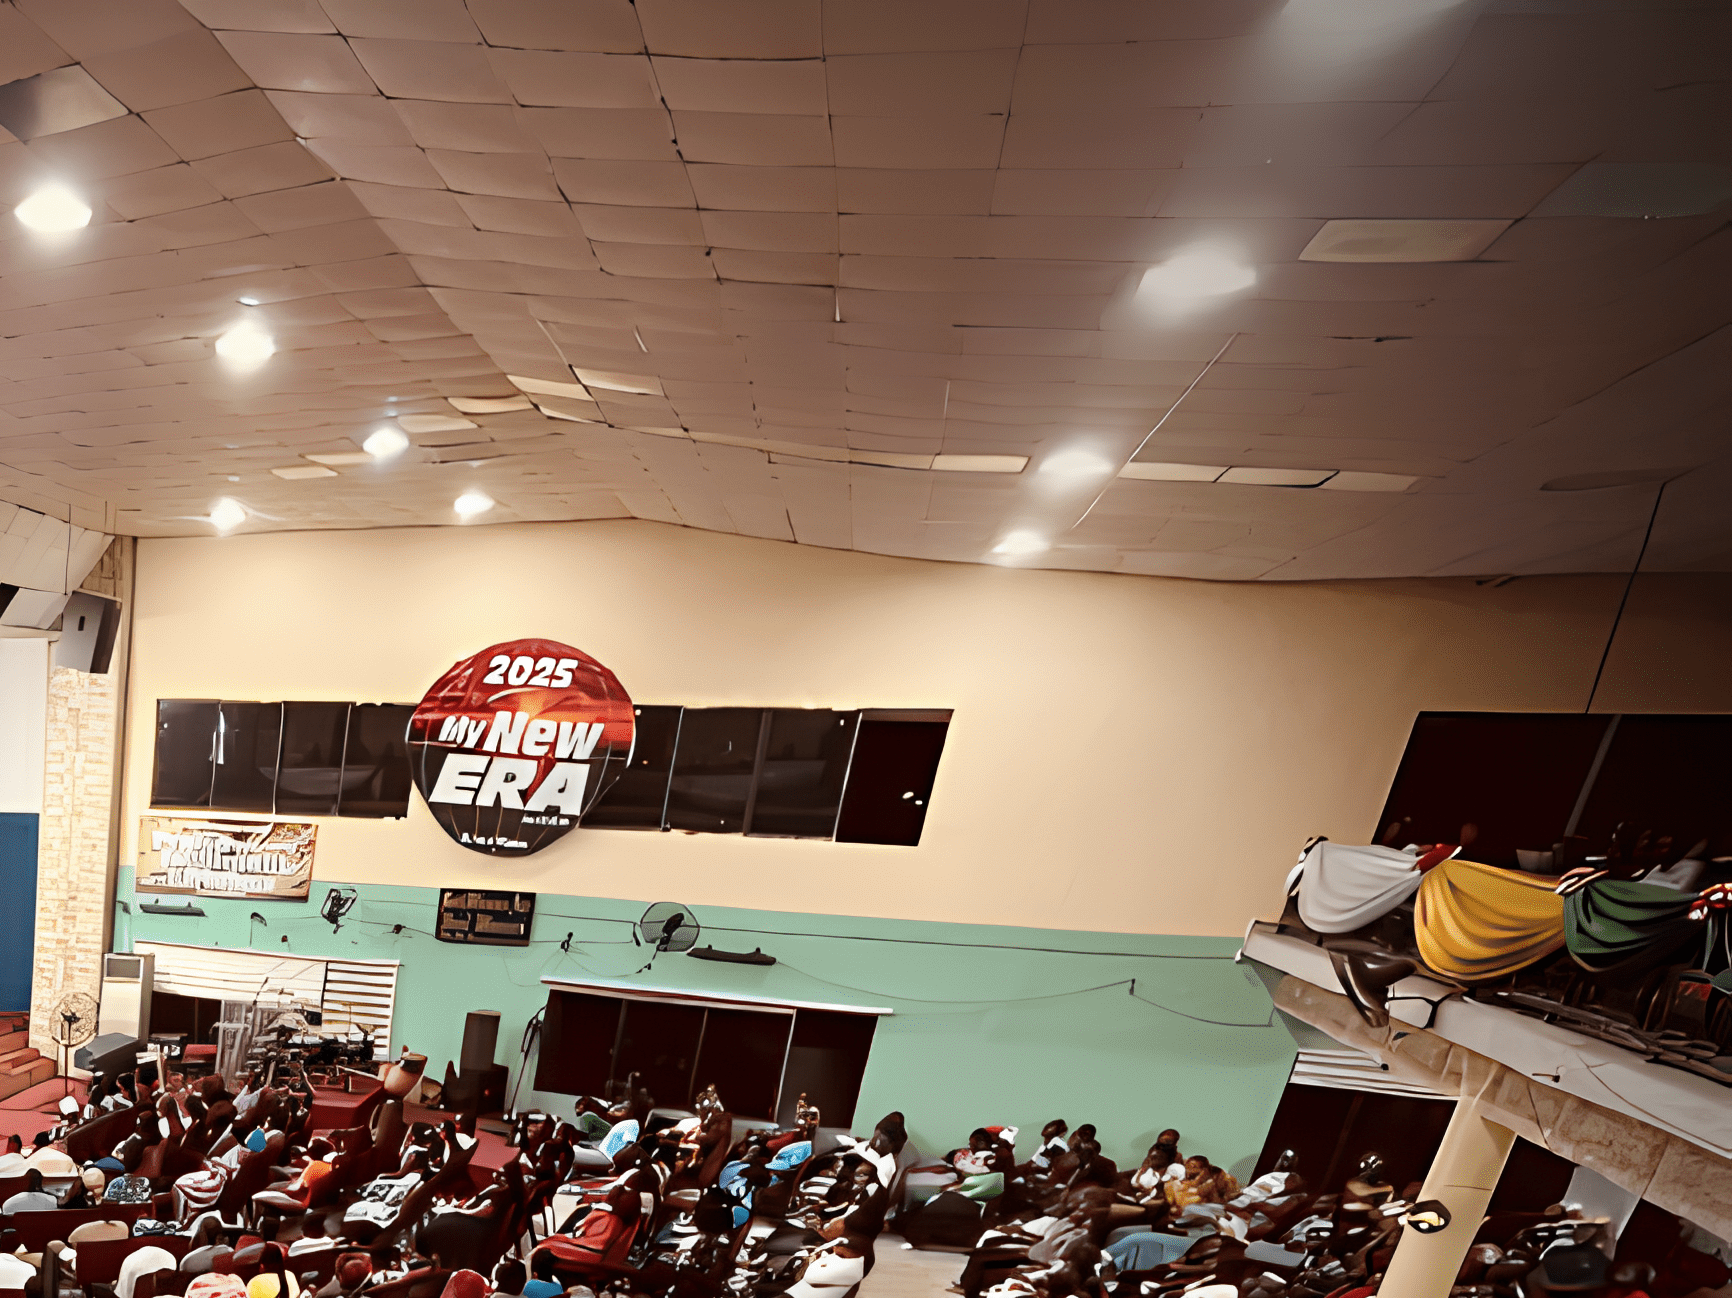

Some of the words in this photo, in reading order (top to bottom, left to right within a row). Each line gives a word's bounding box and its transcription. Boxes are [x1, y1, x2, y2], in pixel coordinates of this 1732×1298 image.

[483, 654, 579, 688] 2025
[438, 715, 488, 749] My
[428, 752, 591, 817] ERA
